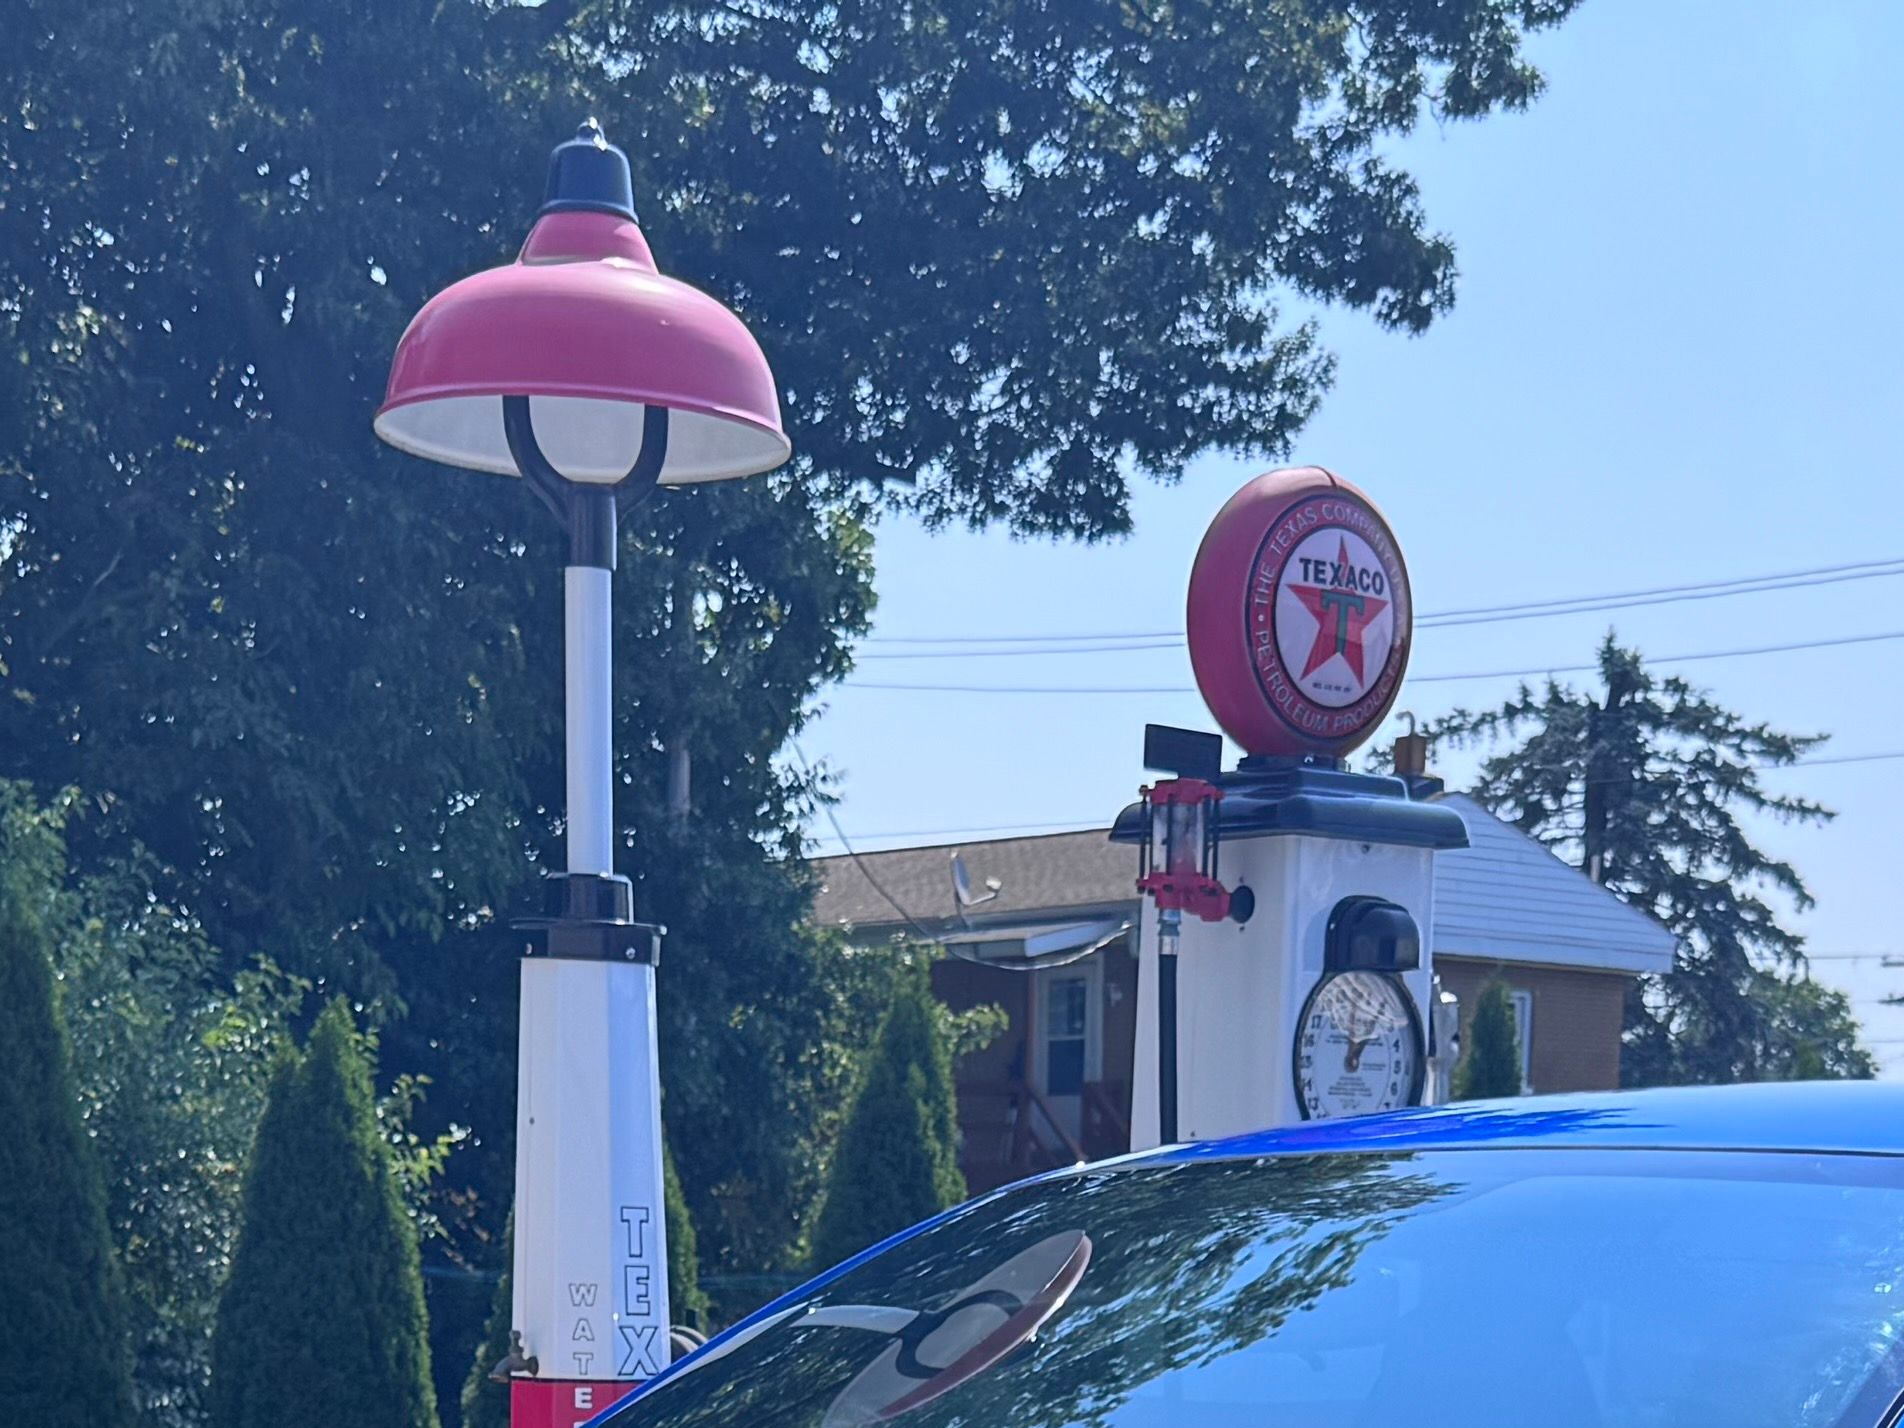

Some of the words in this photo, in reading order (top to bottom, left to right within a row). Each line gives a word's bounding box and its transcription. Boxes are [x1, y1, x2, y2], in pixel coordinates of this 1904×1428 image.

[1255, 561, 1275, 605] THE
[1269, 506, 1318, 556] TEXAS
[1299, 557, 1384, 596] TEXACO
[1256, 630, 1329, 733] PETROLEUM
